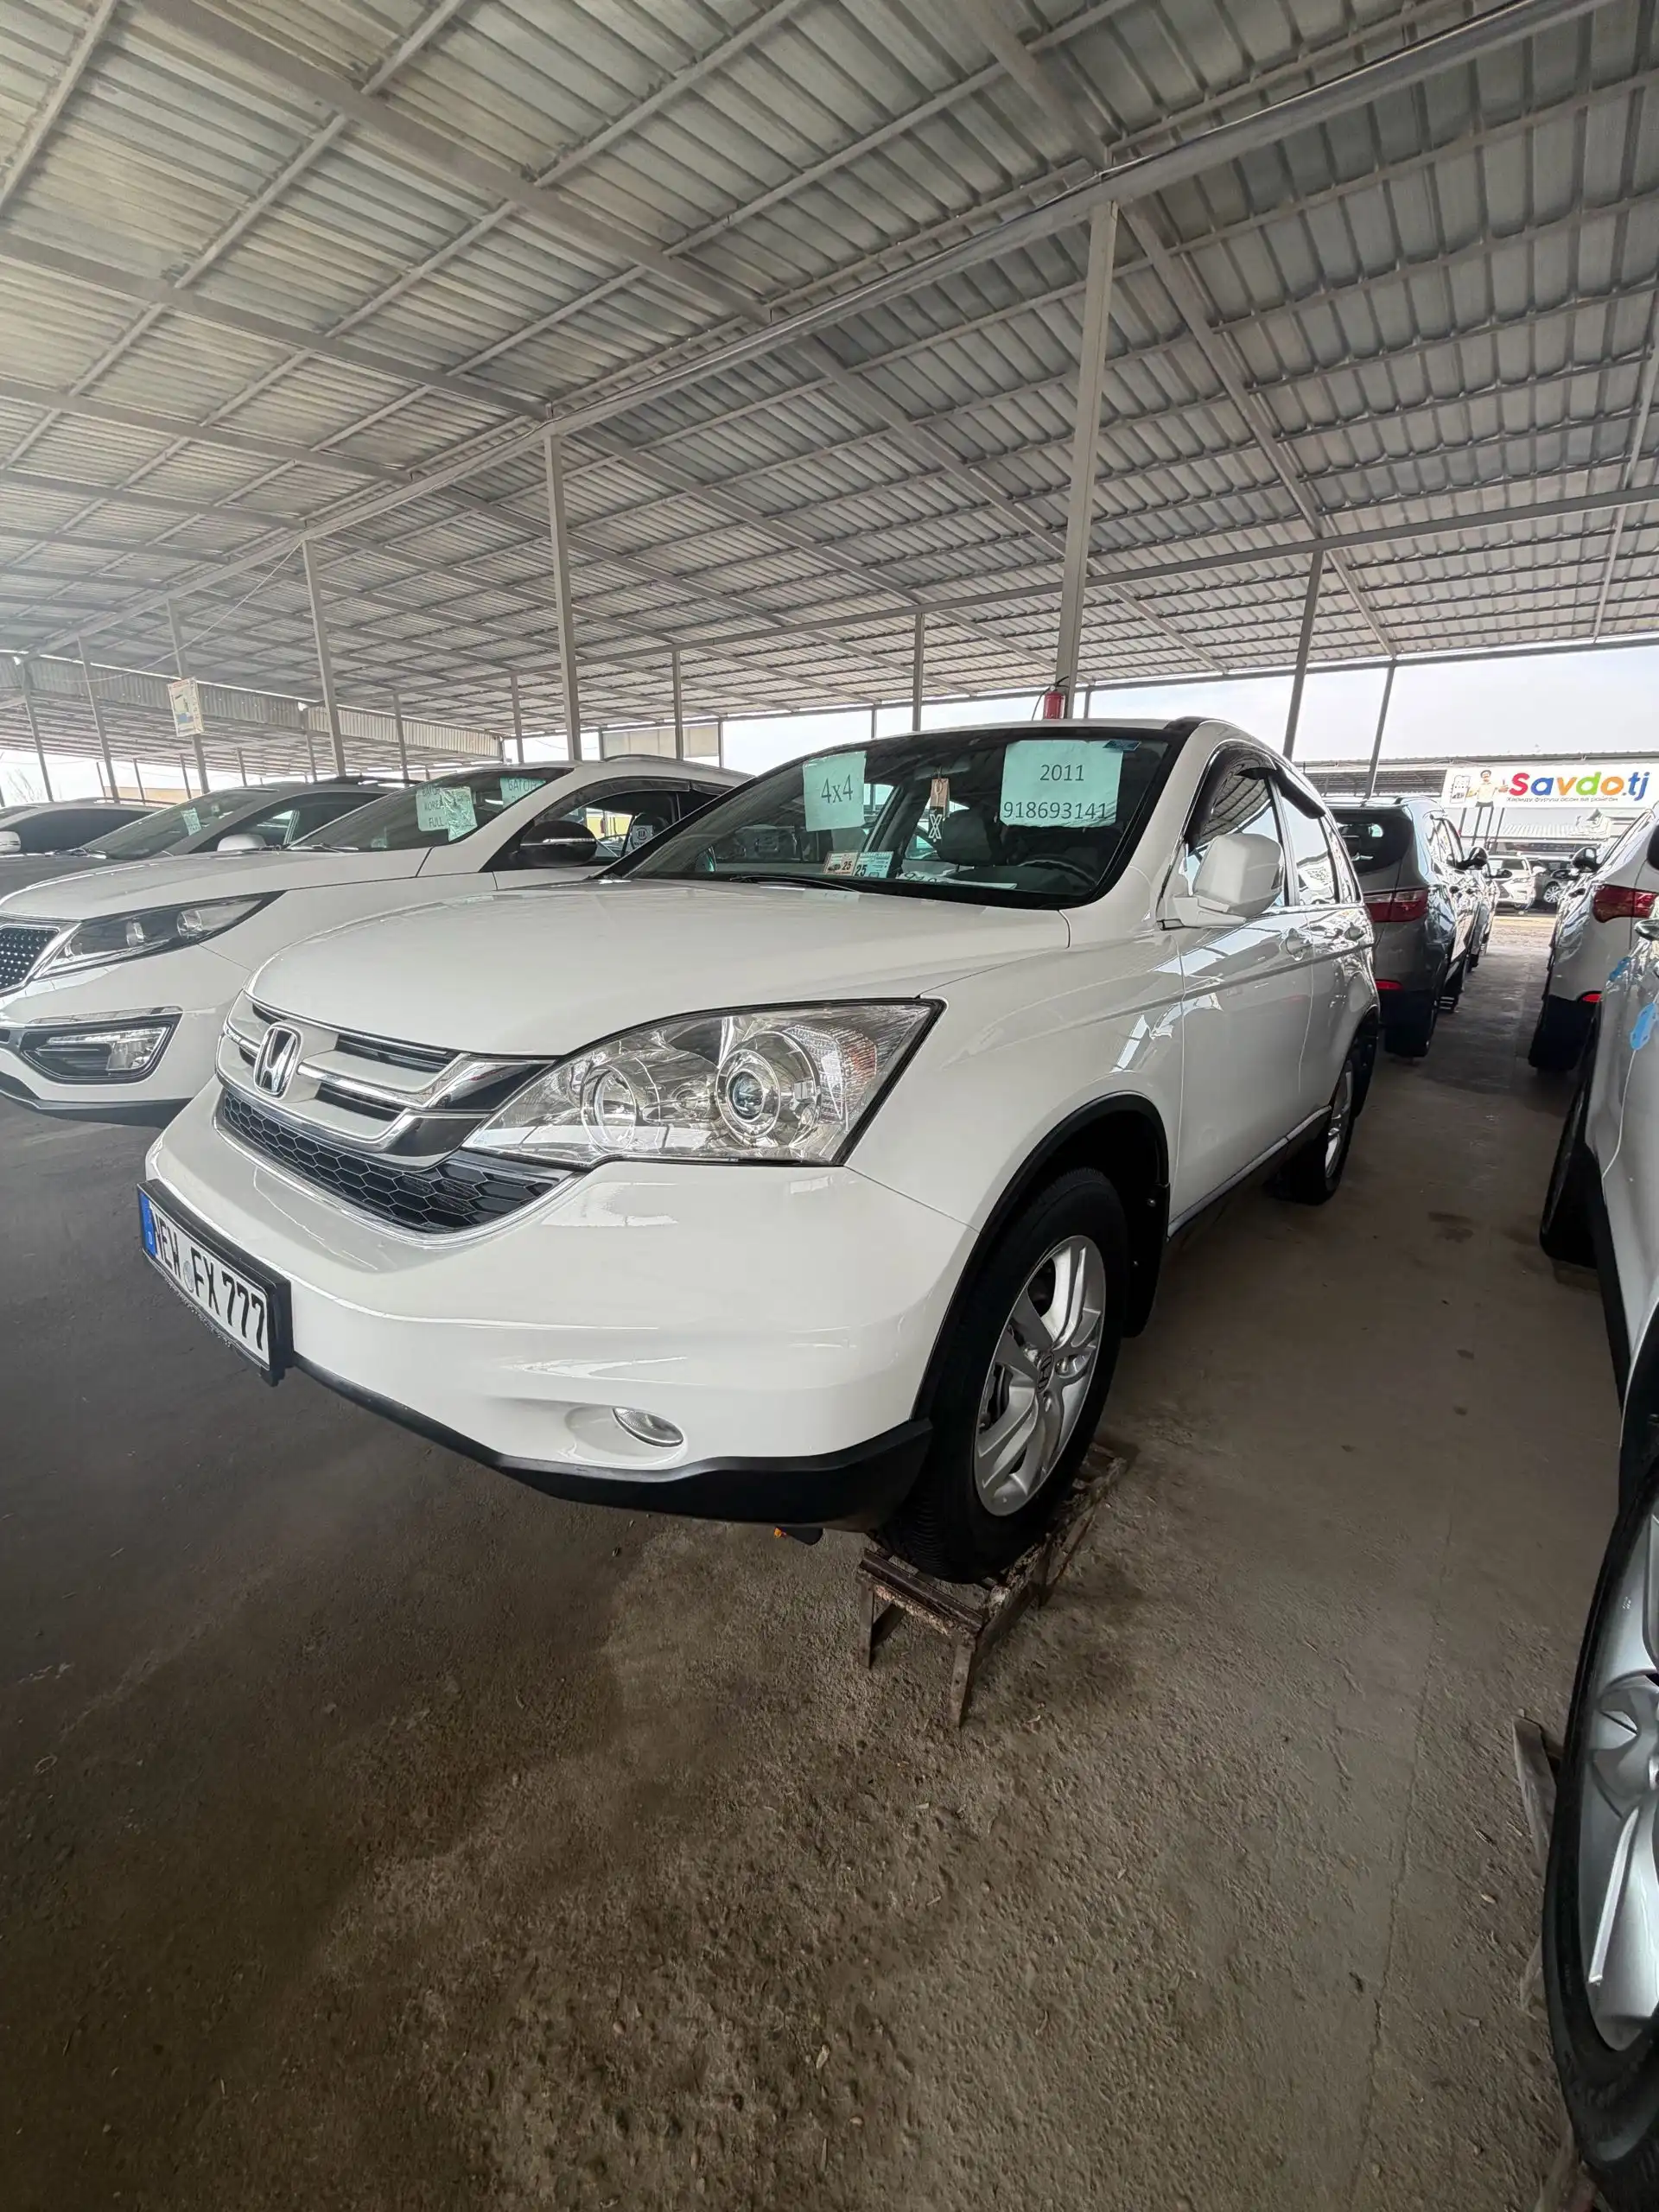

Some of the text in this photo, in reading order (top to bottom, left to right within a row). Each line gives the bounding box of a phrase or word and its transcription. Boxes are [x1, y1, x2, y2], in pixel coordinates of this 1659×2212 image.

[1039, 765, 1084, 781] 2011
[821, 774, 853, 804] 4x4
[1509, 772, 1650, 801] Savdo.tj
[1003, 802, 1107, 819] 918693141
[842, 861, 853, 870] 25
[855, 864, 868, 876] 25
[190, 1246, 221, 1318] FX
[221, 1270, 264, 1351] 777
